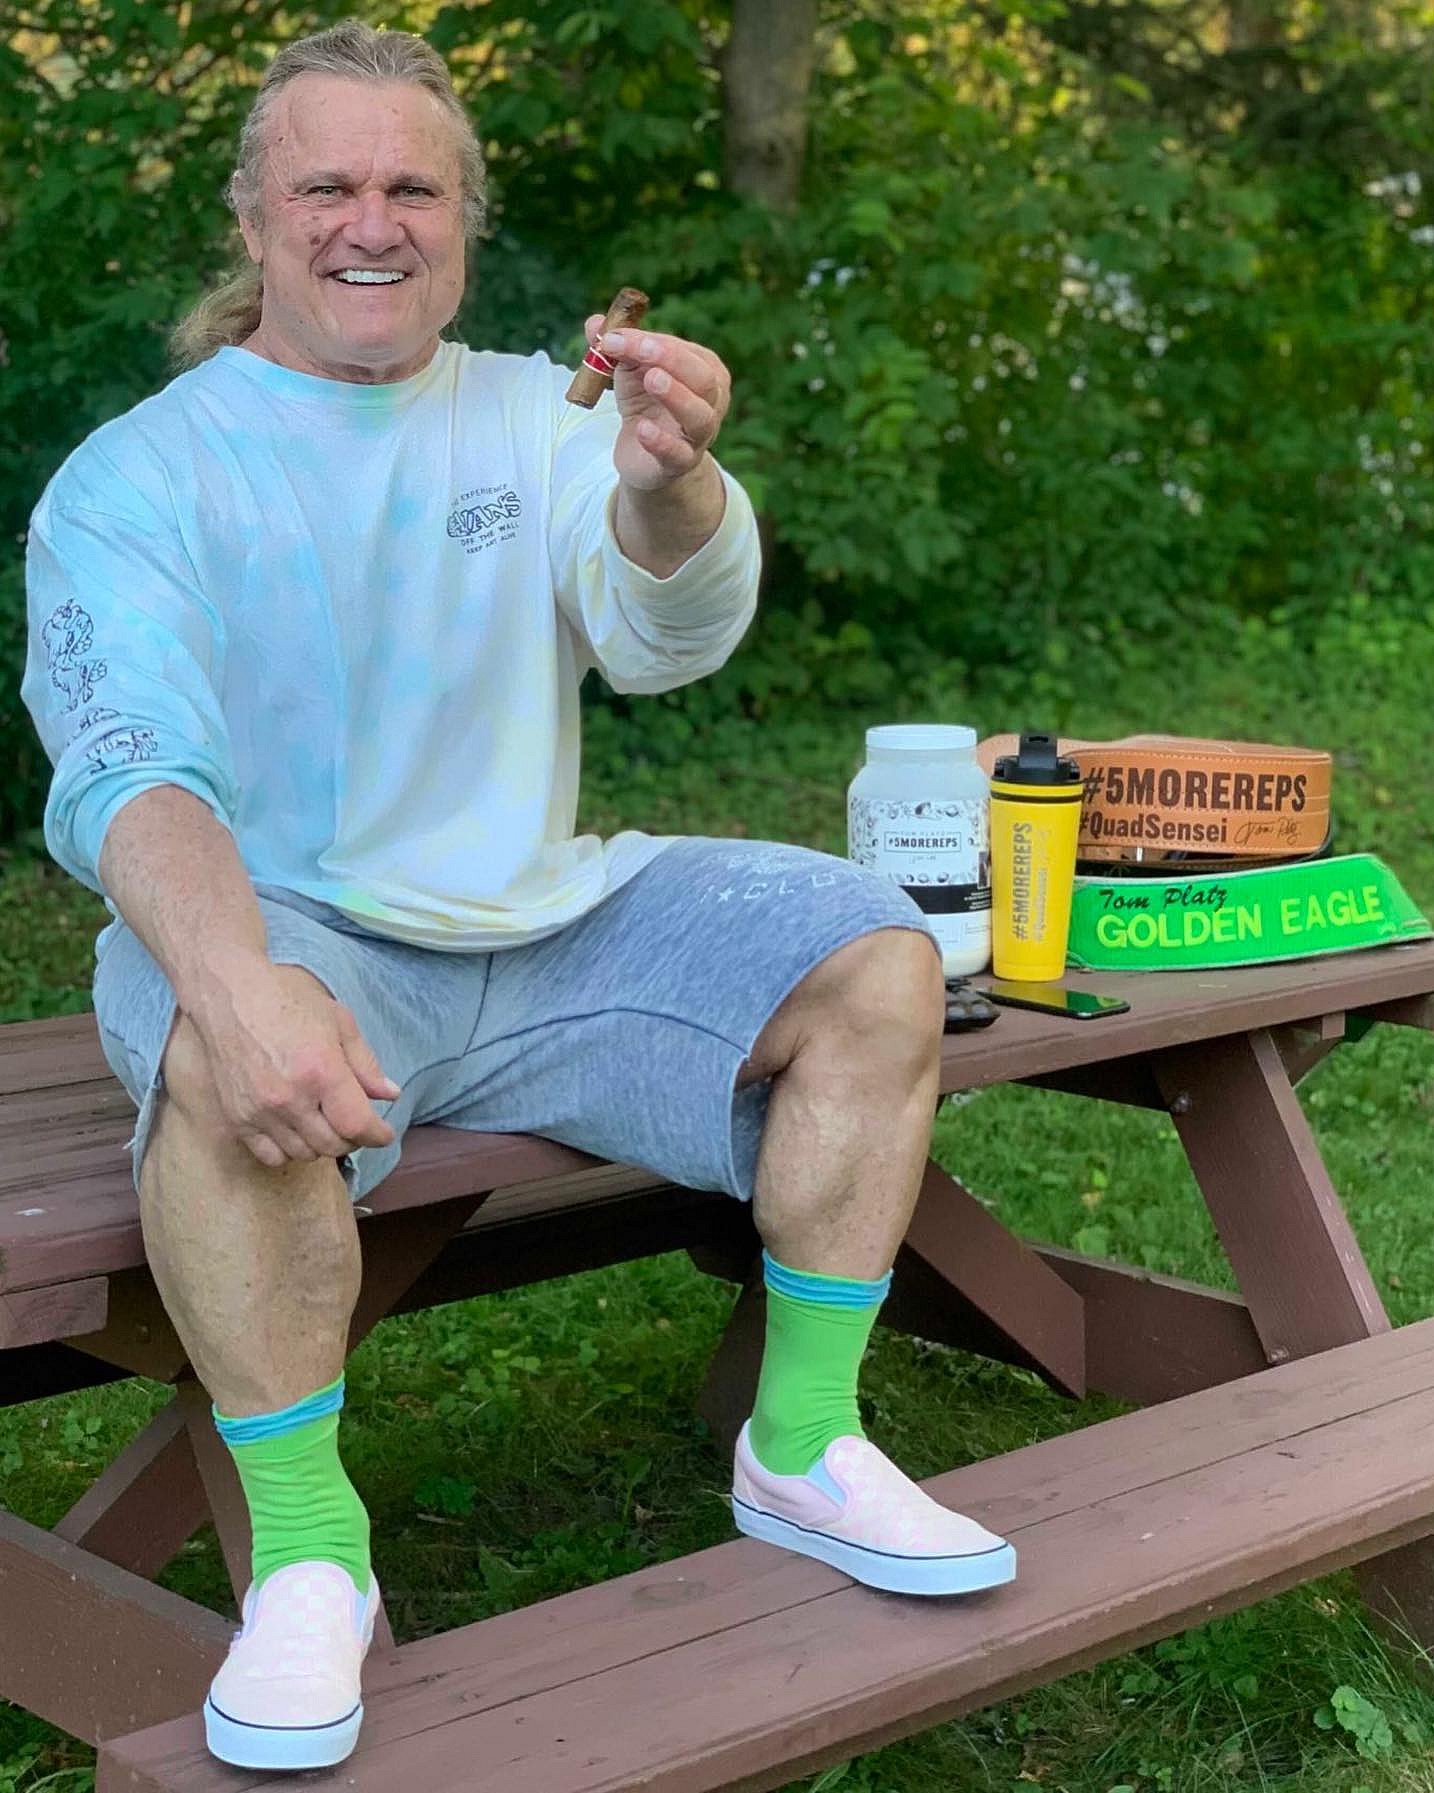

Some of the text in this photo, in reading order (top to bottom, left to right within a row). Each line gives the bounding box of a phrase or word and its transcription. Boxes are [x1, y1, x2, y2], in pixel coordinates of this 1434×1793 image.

[1082, 767, 1308, 812] #5MOREREPS
[1079, 811, 1228, 843] #QuadSensei
[1012, 822, 1033, 942] #5MOREREPS
[1099, 884, 1228, 913] Tom Platz
[1096, 886, 1385, 949] GOLDEN EAGLE
